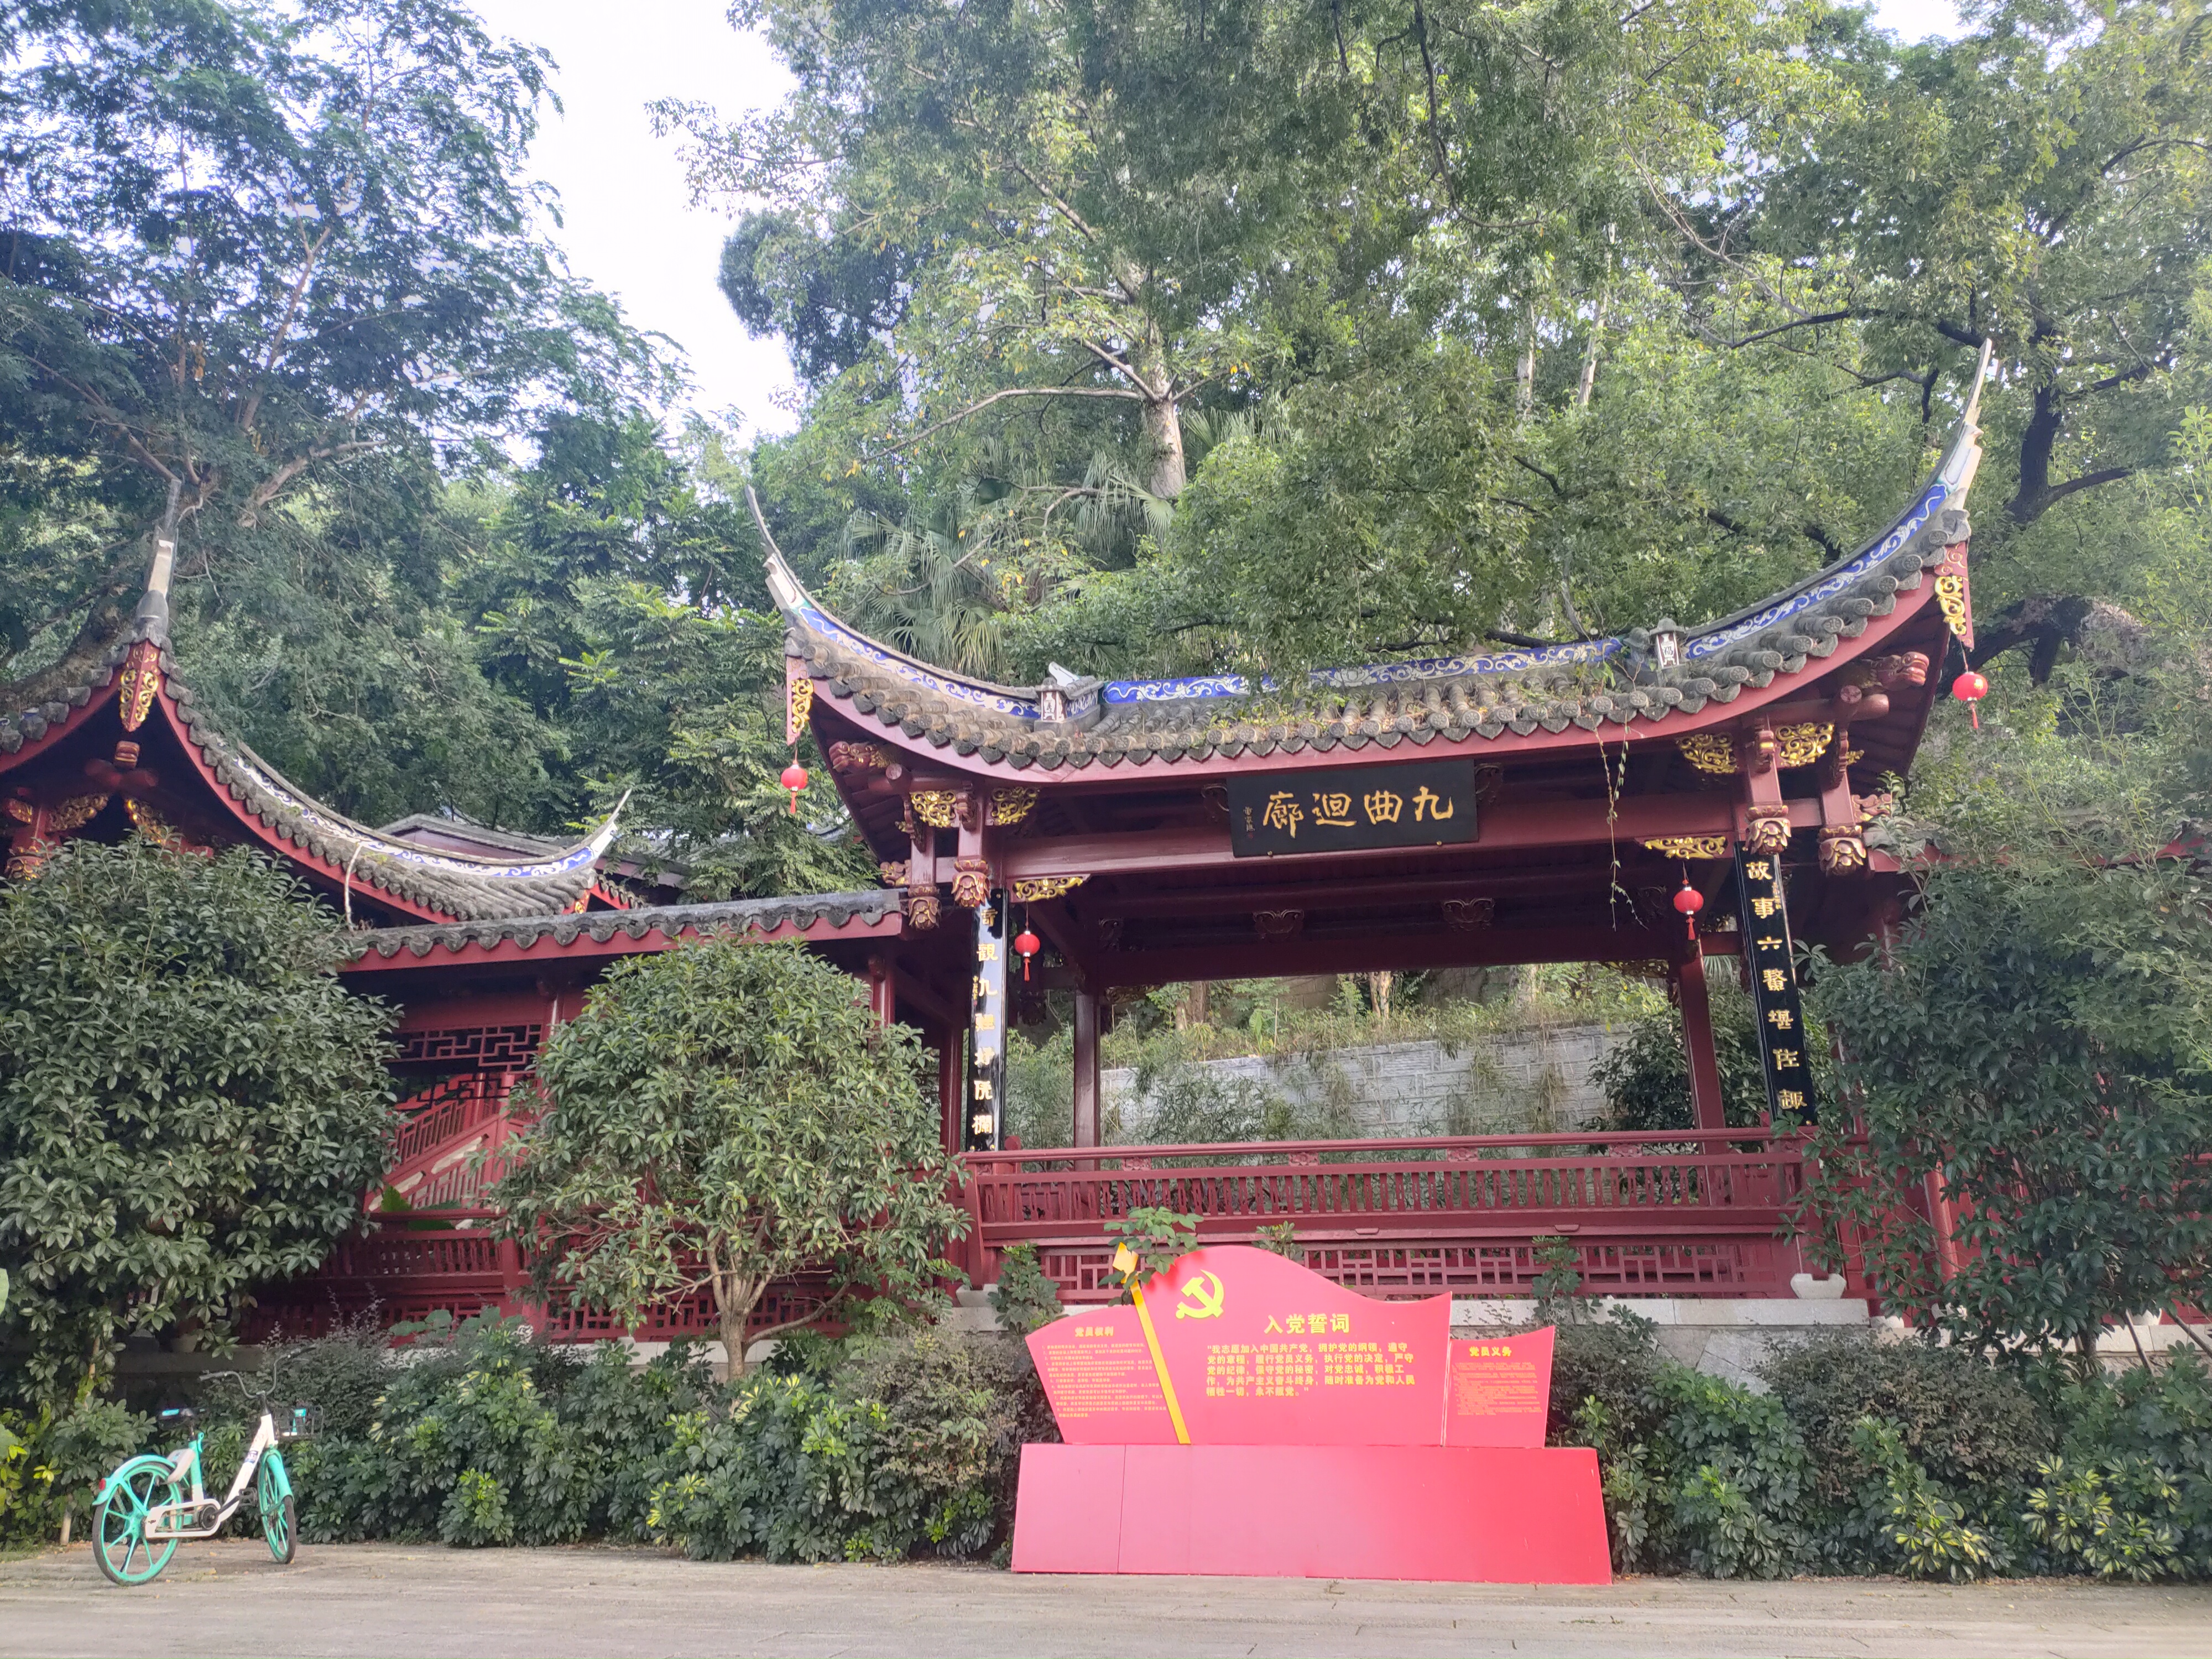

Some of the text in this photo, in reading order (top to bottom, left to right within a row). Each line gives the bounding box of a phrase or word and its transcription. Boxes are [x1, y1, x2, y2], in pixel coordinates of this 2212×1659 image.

[1264, 1313, 1350, 1334] 入党誓词
[1075, 1326, 1114, 1337] 党员权利
[1469, 1346, 1512, 1357] 党员义务
